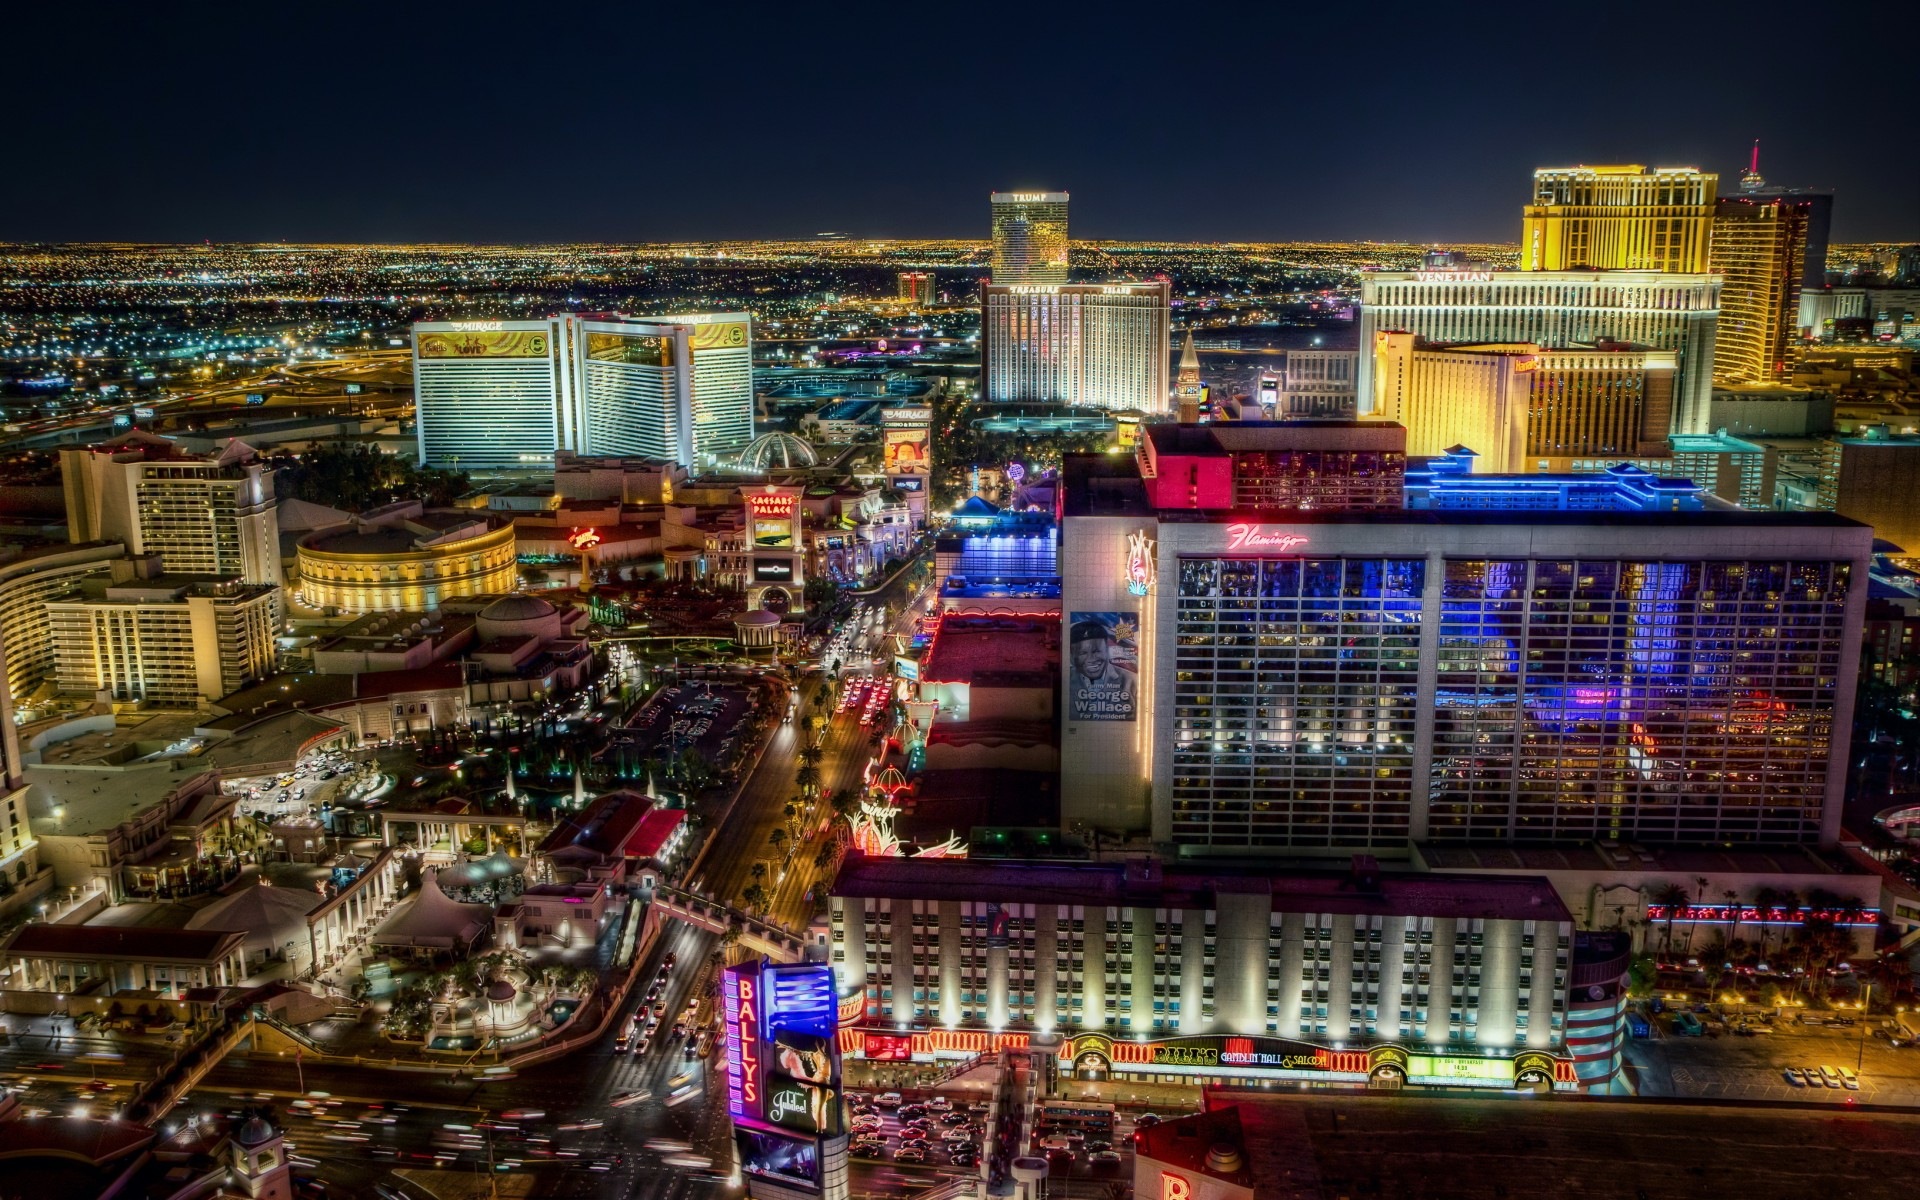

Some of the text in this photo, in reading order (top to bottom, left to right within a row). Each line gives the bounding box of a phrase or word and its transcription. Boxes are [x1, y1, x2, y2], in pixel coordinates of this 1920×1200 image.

[1417, 272, 1490, 281] VENETIAN
[1010, 286, 1131, 294] TREASURE ISLAND
[675, 315, 712, 324] MIRAGE
[459, 322, 502, 332] MIRAGE
[460, 345, 481, 354] LOVE
[887, 411, 930, 420] MIRAGE
[751, 496, 793, 505] CAESARS
[753, 505, 791, 514] PALACE
[1226, 523, 1308, 552] Flamingo
[1077, 688, 1130, 703] George
[1074, 700, 1132, 712] Wallace
[739, 979, 756, 1102] BALLYS
[1152, 1047, 1218, 1066] BILL'S
[1261, 1053, 1283, 1064] HALL
[1283, 1055, 1293, 1069] &
[1292, 1055, 1328, 1066] SALOON
